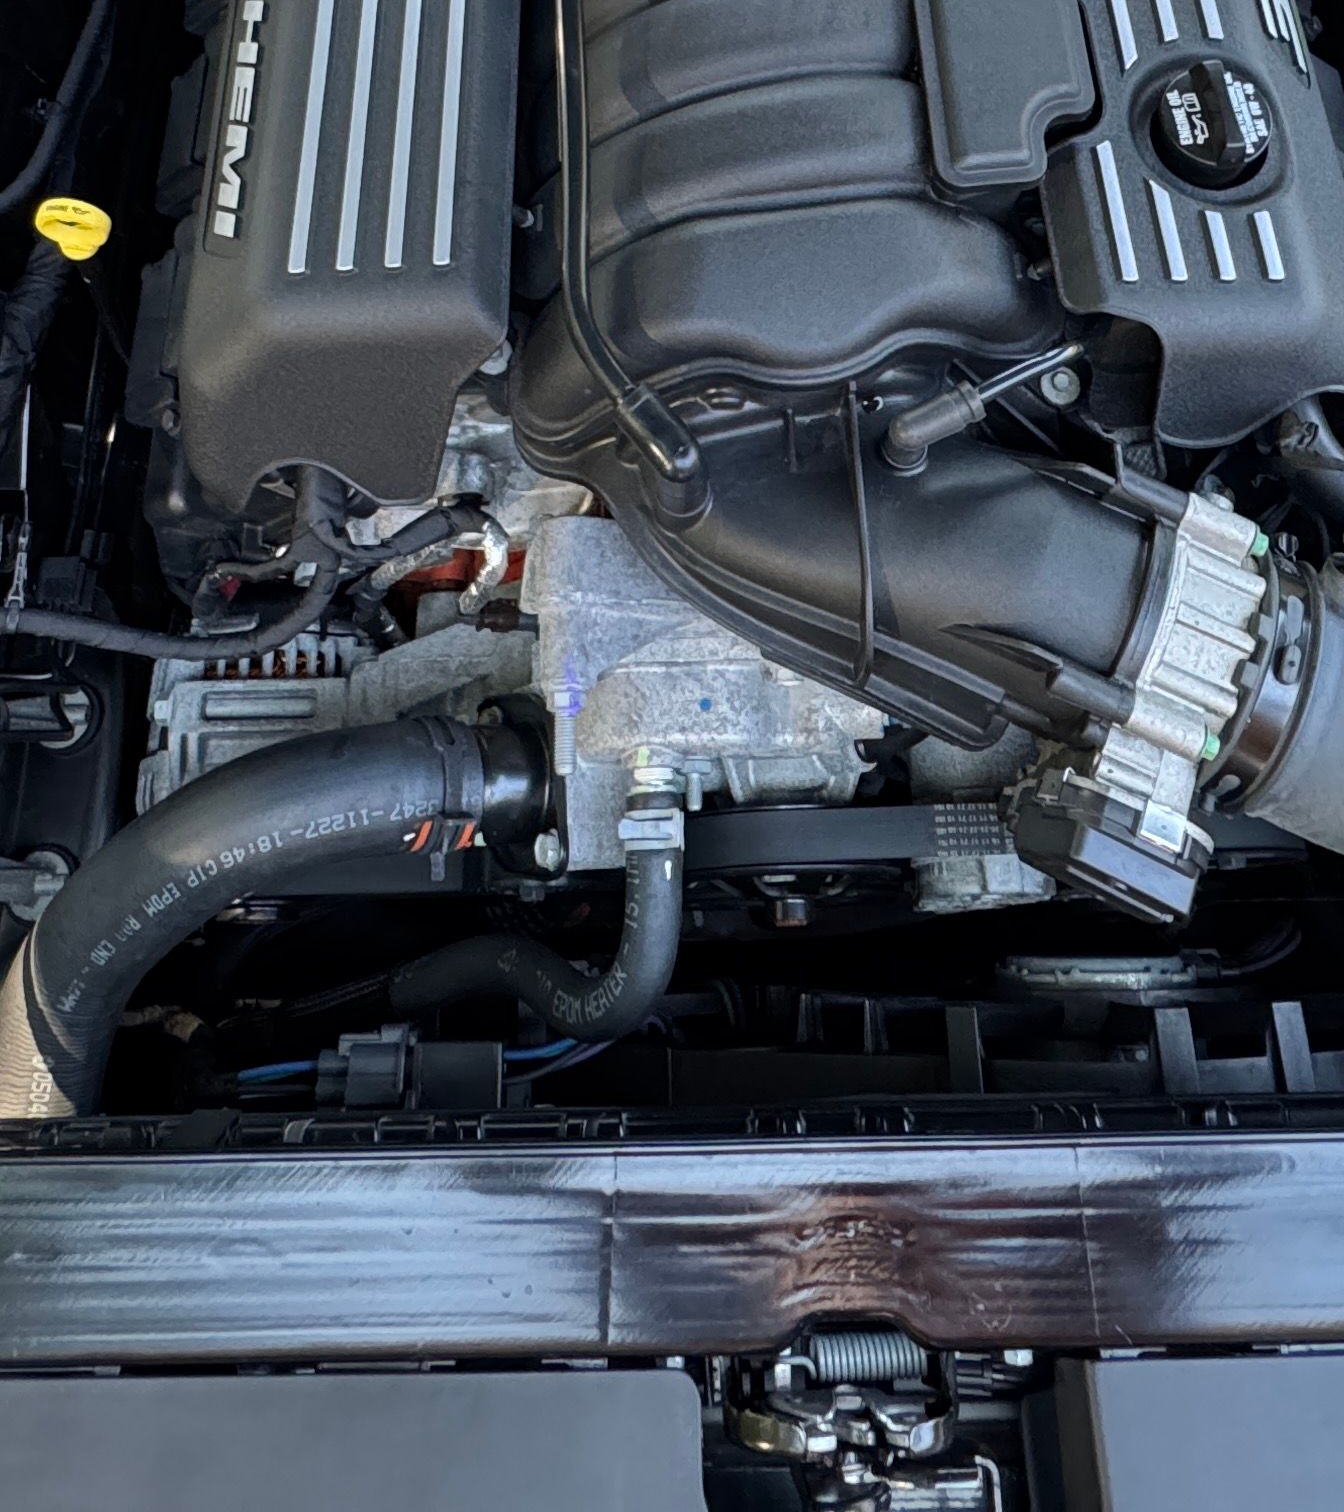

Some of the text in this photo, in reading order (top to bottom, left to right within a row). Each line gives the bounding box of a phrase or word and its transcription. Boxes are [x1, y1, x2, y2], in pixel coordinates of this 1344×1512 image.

[212, 0, 265, 239] HEMI
[1166, 89, 1194, 146] ENGINE OIL
[1253, 118, 1269, 137] SAE
[187, 860, 218, 888] CIP
[142, 882, 182, 918] EPDM
[552, 989, 583, 1024] EPDM
[584, 961, 628, 1022] HEATER
